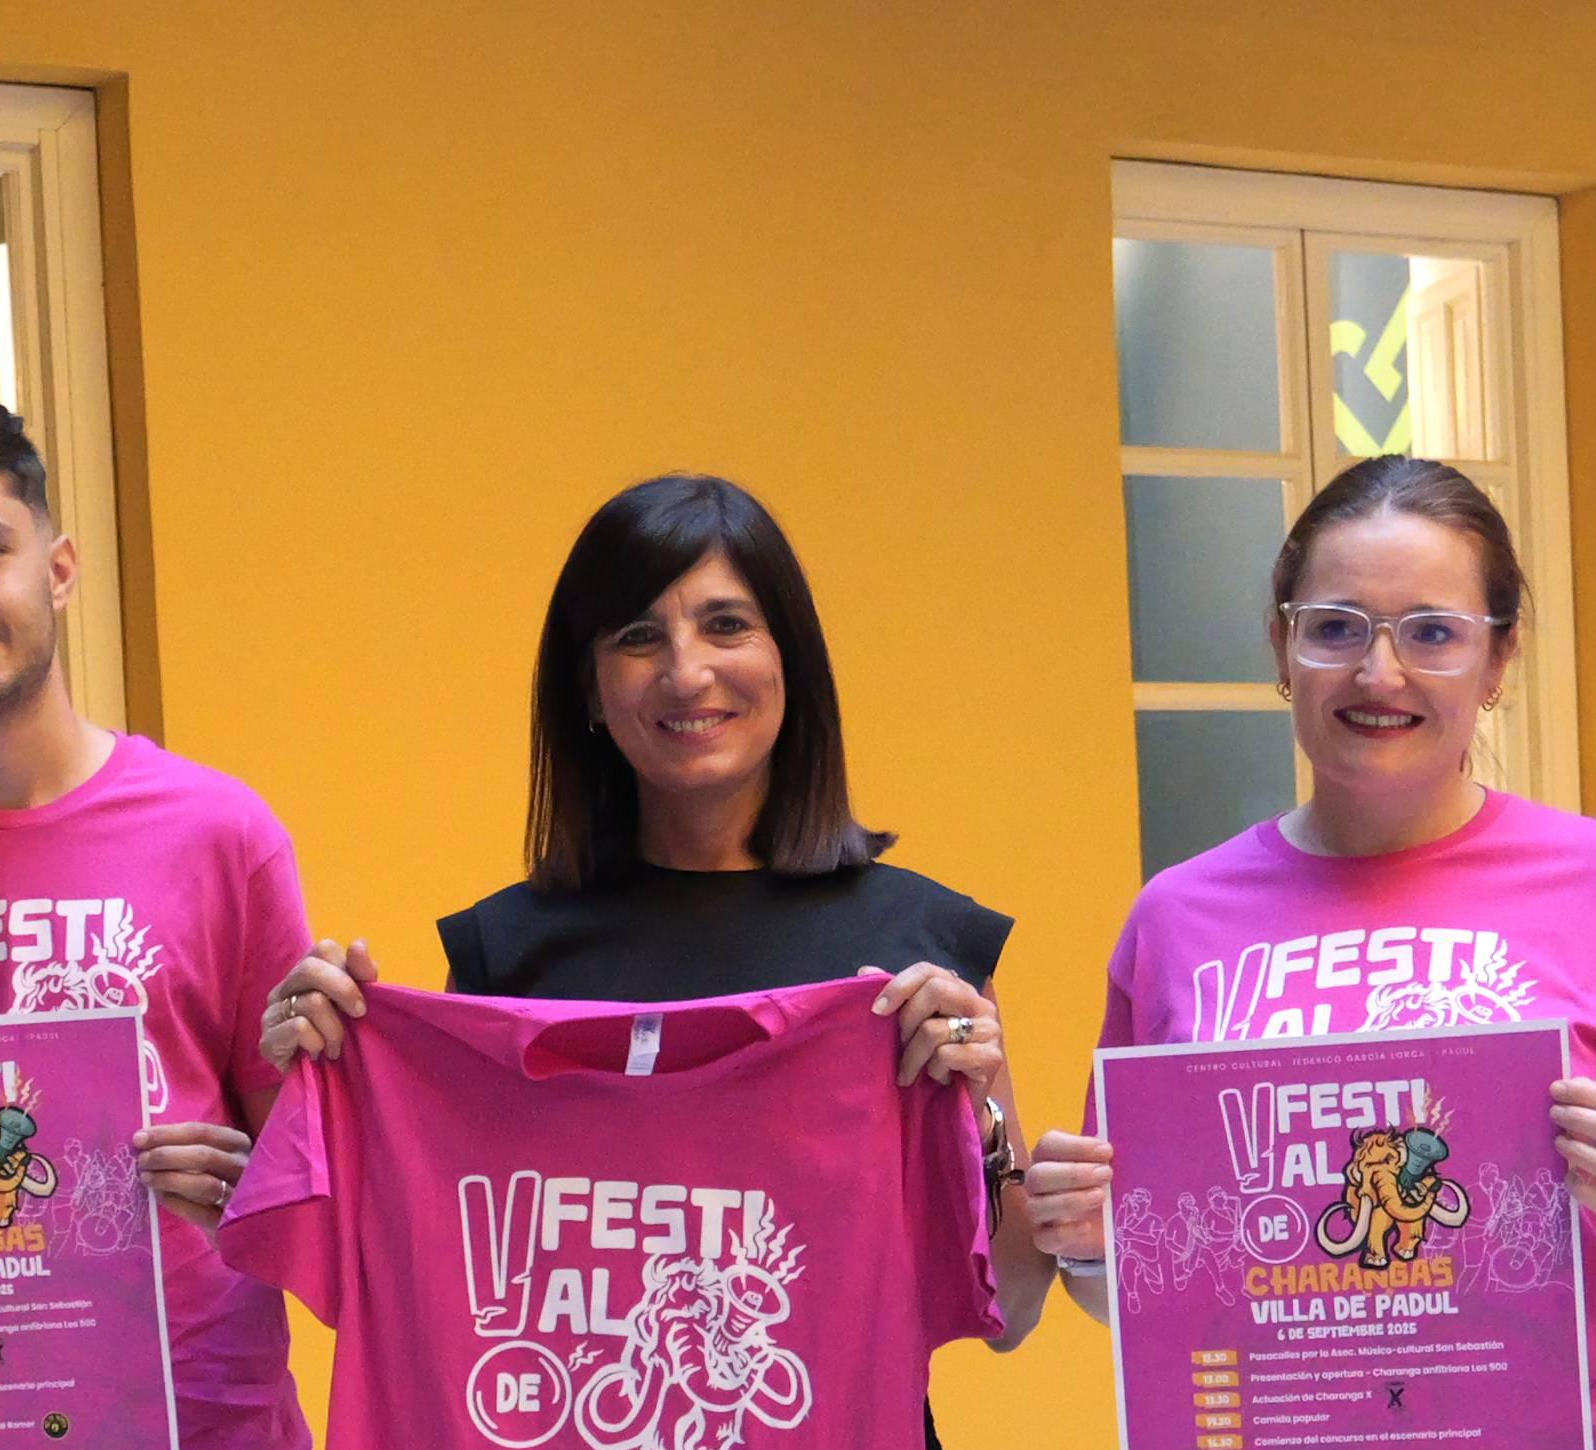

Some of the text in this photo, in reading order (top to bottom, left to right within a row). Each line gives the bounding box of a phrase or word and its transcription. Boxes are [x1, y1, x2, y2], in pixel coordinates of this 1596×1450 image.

[1265, 925, 1499, 999] FESTI
[1186, 1062, 1226, 1073] CENTRO
[1231, 1060, 1281, 1071] CULTURAL
[1292, 1056, 1342, 1067] FEDERICO
[1218, 1078, 1426, 1194] V FESTI
[1282, 1141, 1345, 1187] AL
[1258, 1214, 1289, 1243] DE
[458, 1170, 766, 1337] V FESTI
[1246, 1256, 1454, 1296] CHARANGAS
[537, 1267, 637, 1336] AL
[1250, 1291, 1458, 1324] VILLA DE PADUL
[1277, 1322, 1418, 1341] 6 DE SEPTIEMBRE 2025
[1249, 1351, 1300, 1362] Pasacalles
[1302, 1351, 1317, 1362] por
[1436, 1343, 1454, 1353] San
[1456, 1340, 1504, 1351] Sebastián
[1251, 1363, 1487, 1383] Presentación apertura Charanga anfitriona Los
[496, 1372, 541, 1414] DE
[1252, 1390, 1364, 1404] Actuación de Charanga
[1253, 1413, 1331, 1425] Comida popular
[1255, 1428, 1481, 1447] Comienzo del concurso escenario principal
